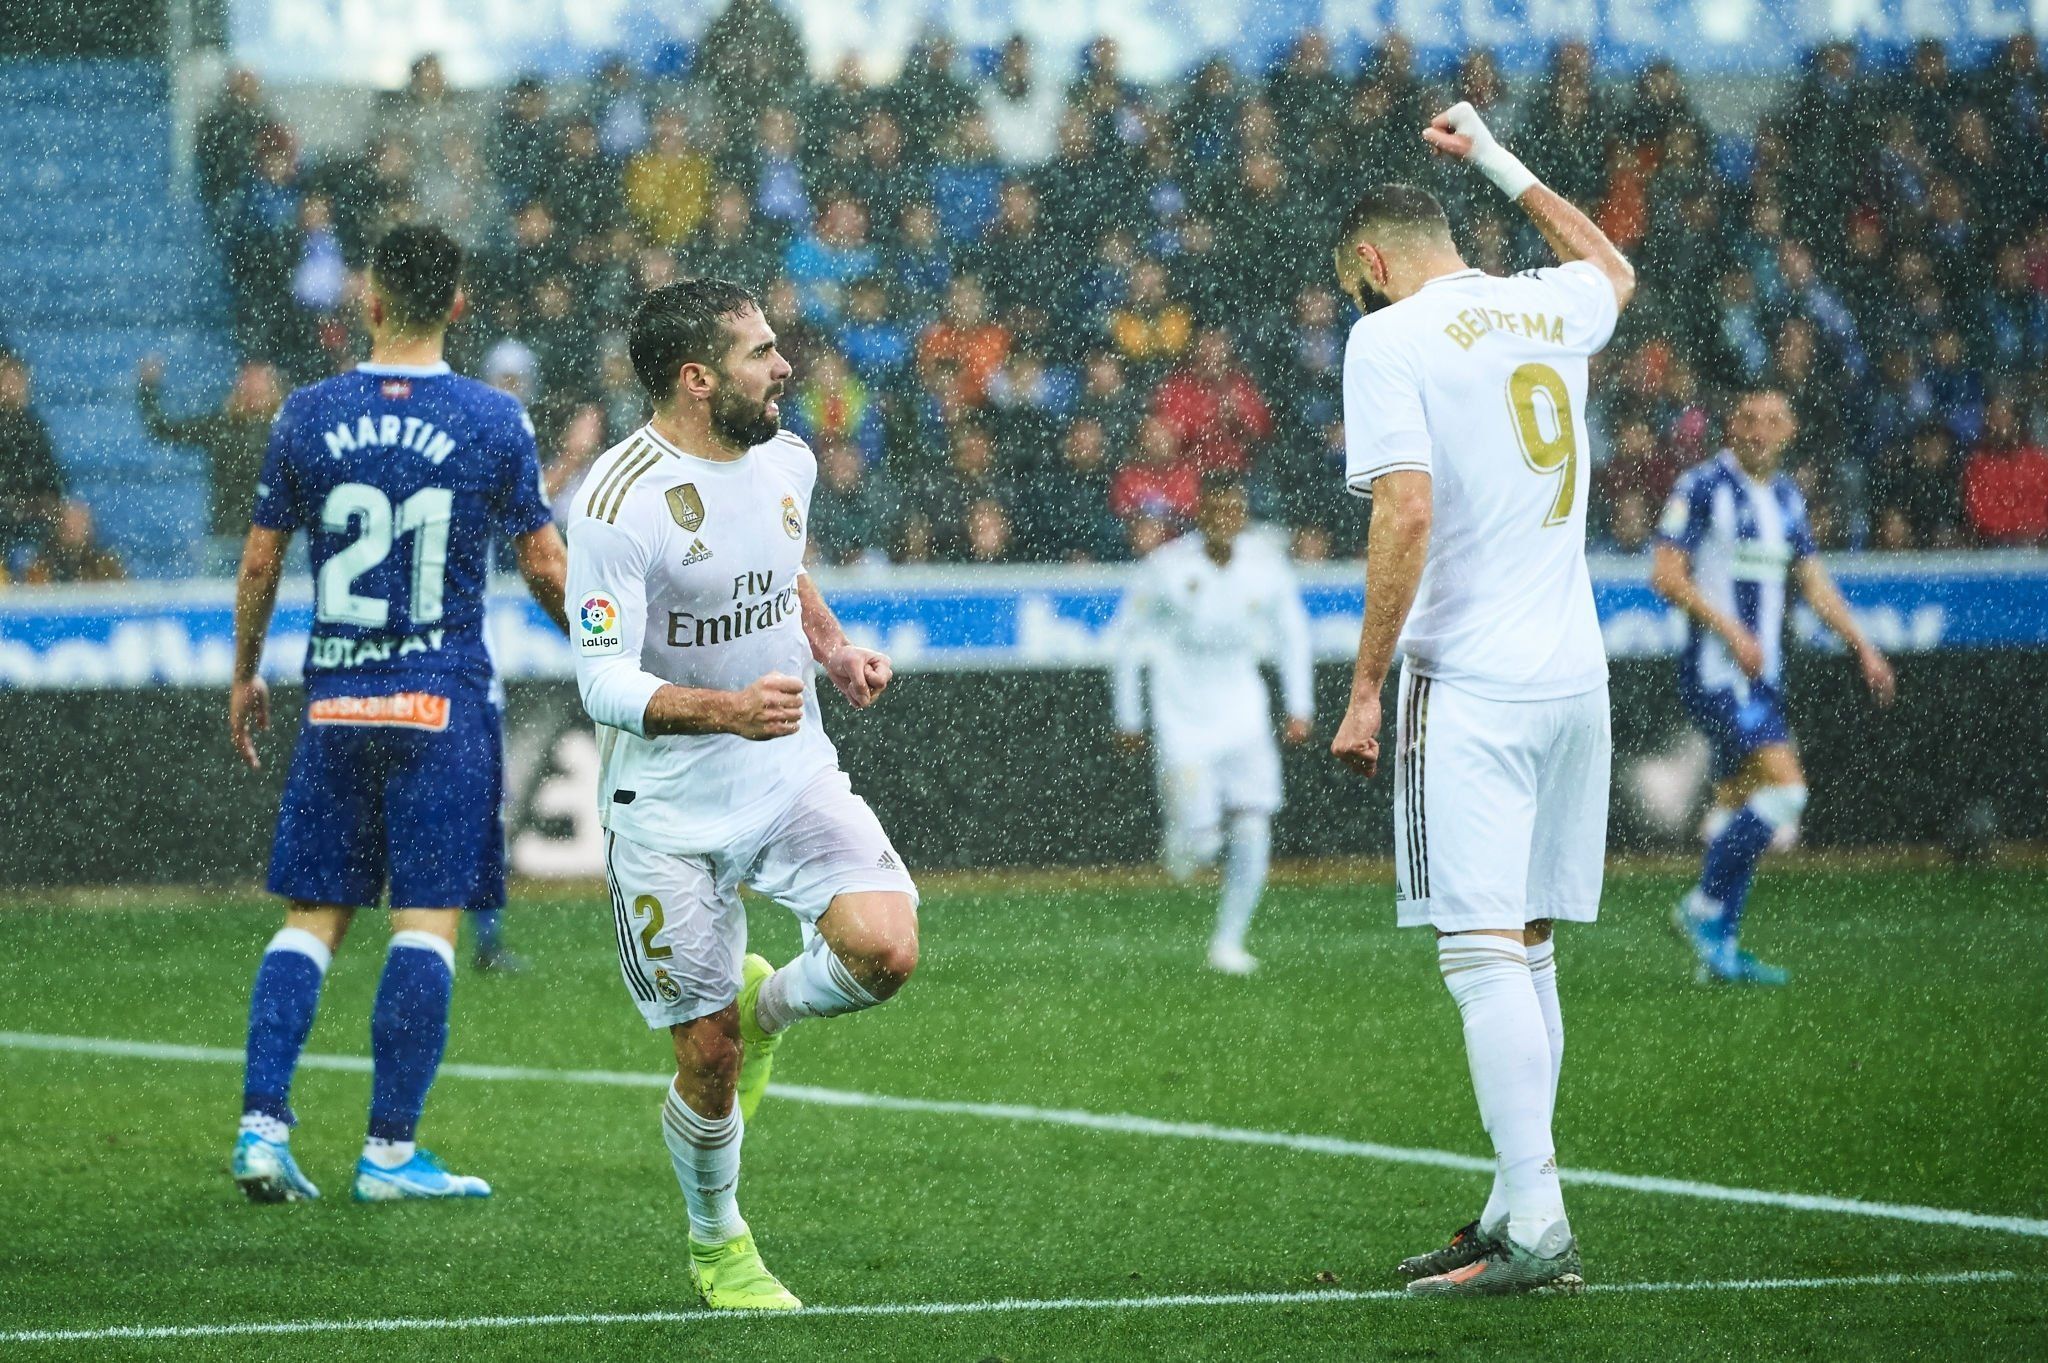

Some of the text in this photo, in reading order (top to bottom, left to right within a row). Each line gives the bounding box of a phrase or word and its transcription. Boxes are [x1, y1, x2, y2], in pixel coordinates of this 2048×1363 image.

[324, 415, 456, 465] MARTIN
[1505, 362, 1577, 529] 9
[320, 483, 454, 627] 21
[682, 551, 713, 566] adidas
[732, 571, 773, 600] Fly
[582, 636, 618, 647] LaLiga
[633, 894, 674, 961] 2
